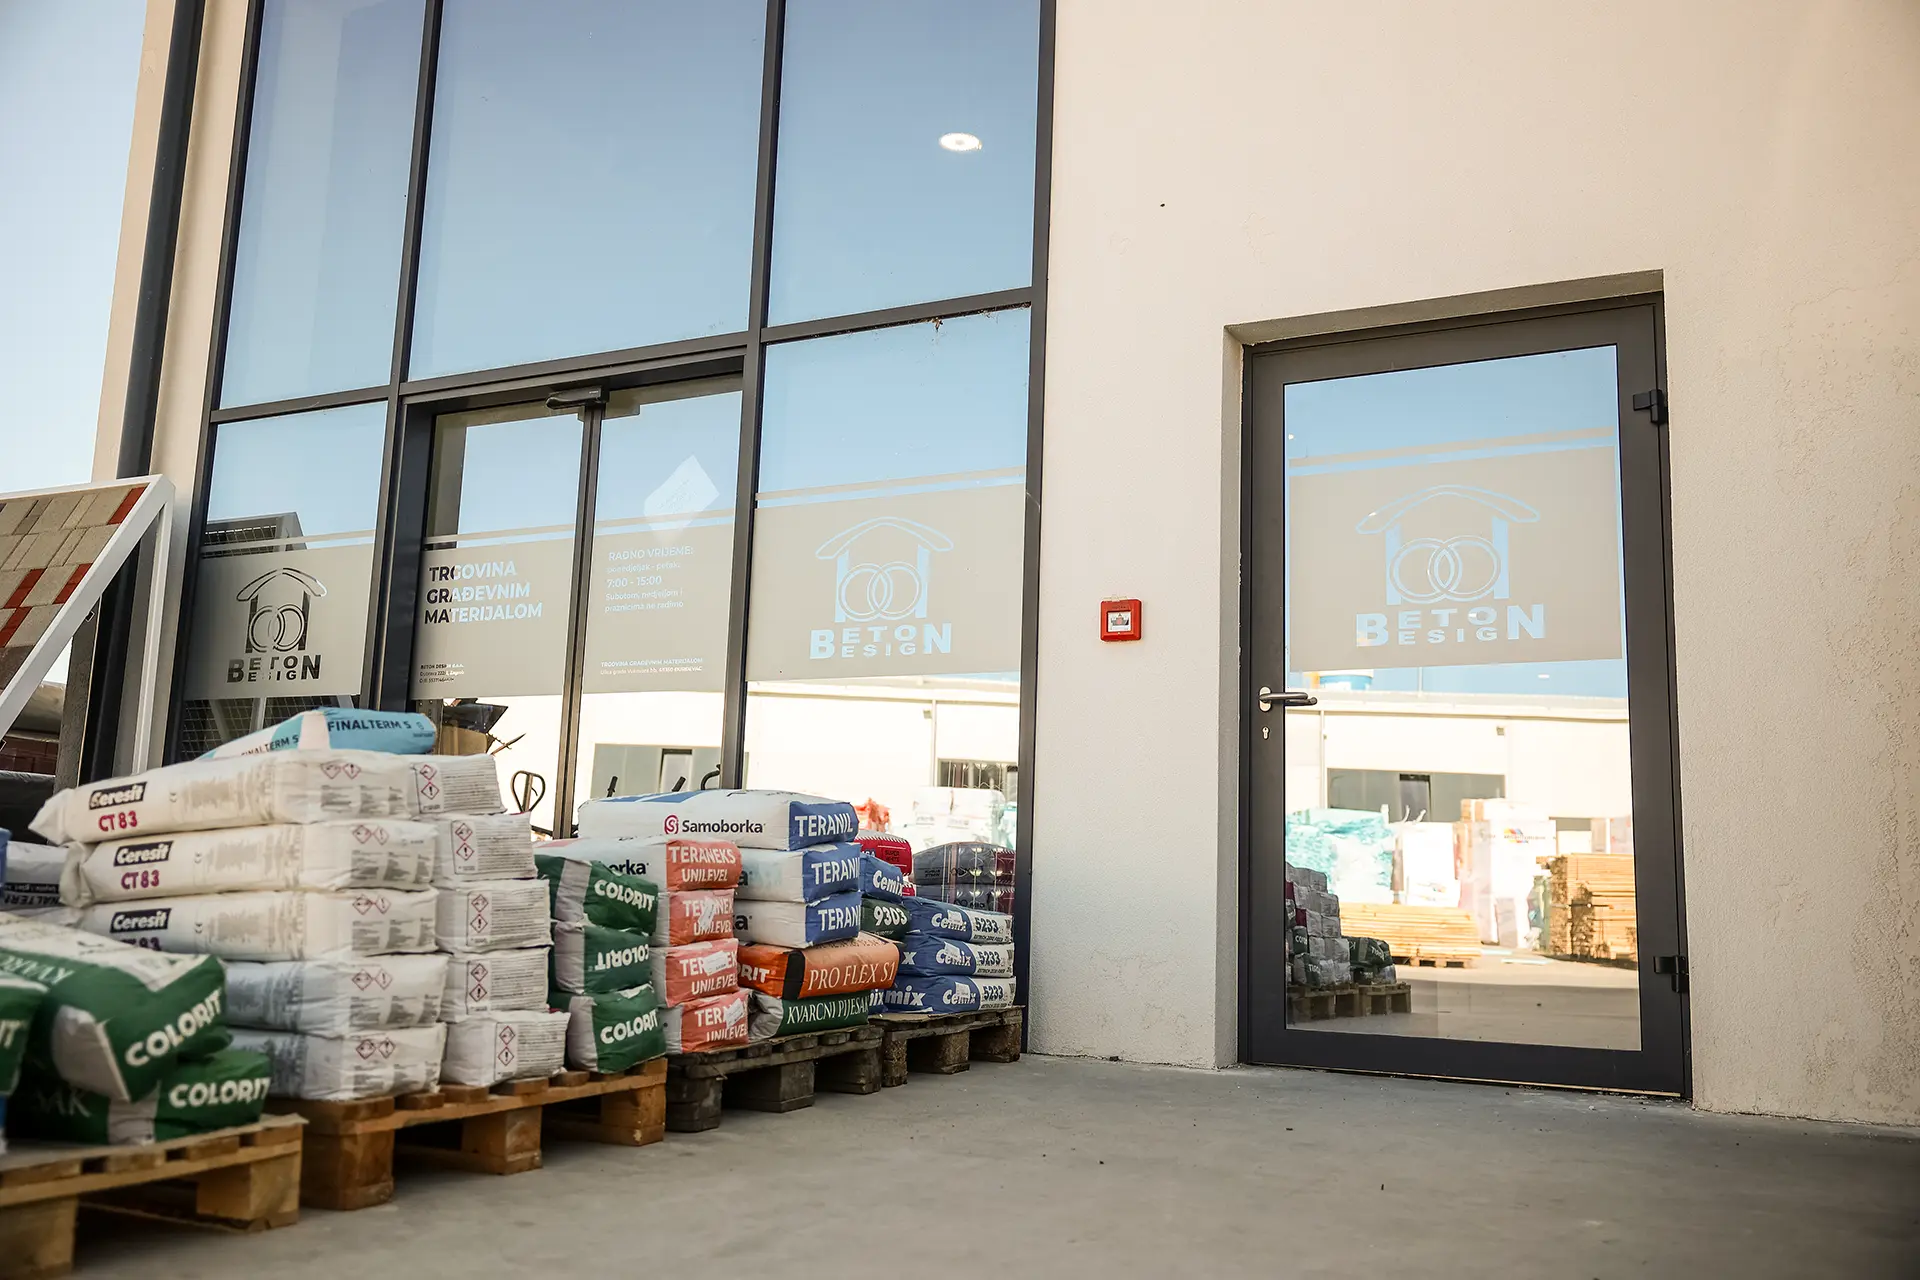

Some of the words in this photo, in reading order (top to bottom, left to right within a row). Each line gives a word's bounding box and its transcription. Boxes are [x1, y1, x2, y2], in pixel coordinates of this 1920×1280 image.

[608, 550, 645, 561] RADNO
[429, 561, 517, 582] TRGOVINA
[606, 577, 628, 588] 7:00
[636, 575, 662, 586] 15:00
[427, 582, 531, 604] GRAĐEVNIM
[424, 602, 543, 624] MATERIJALOM
[327, 718, 402, 732] FINALTERM
[405, 719, 412, 729] S
[292, 734, 299, 744] S
[91, 784, 144, 808] Ceresit
[98, 813, 115, 832] CT
[118, 810, 138, 829] 83
[681, 819, 763, 834] Samoborka
[794, 812, 854, 838] TERANIL
[116, 843, 169, 864] Ceresit
[668, 846, 736, 865] TERANEKS
[121, 872, 139, 890] CT
[140, 869, 160, 888] 83
[681, 868, 729, 883] UNILEVEL
[872, 870, 903, 897] Cemix
[594, 879, 655, 912] COLORIT
[112, 911, 168, 929] Ceresit
[873, 905, 908, 926] 9303
[974, 917, 999, 934] 5233
[978, 951, 1001, 966] 5233
[691, 974, 738, 995] UNILEVEL
[808, 967, 840, 991] PRO
[843, 963, 879, 986] FLEX
[880, 961, 896, 982] S1
[982, 986, 1004, 1000] 5233
[786, 1001, 837, 1024] KVARCNI
[125, 990, 223, 1066] COLORIT
[600, 1009, 658, 1044] COLORIT
[168, 1077, 271, 1108] COLORIT
